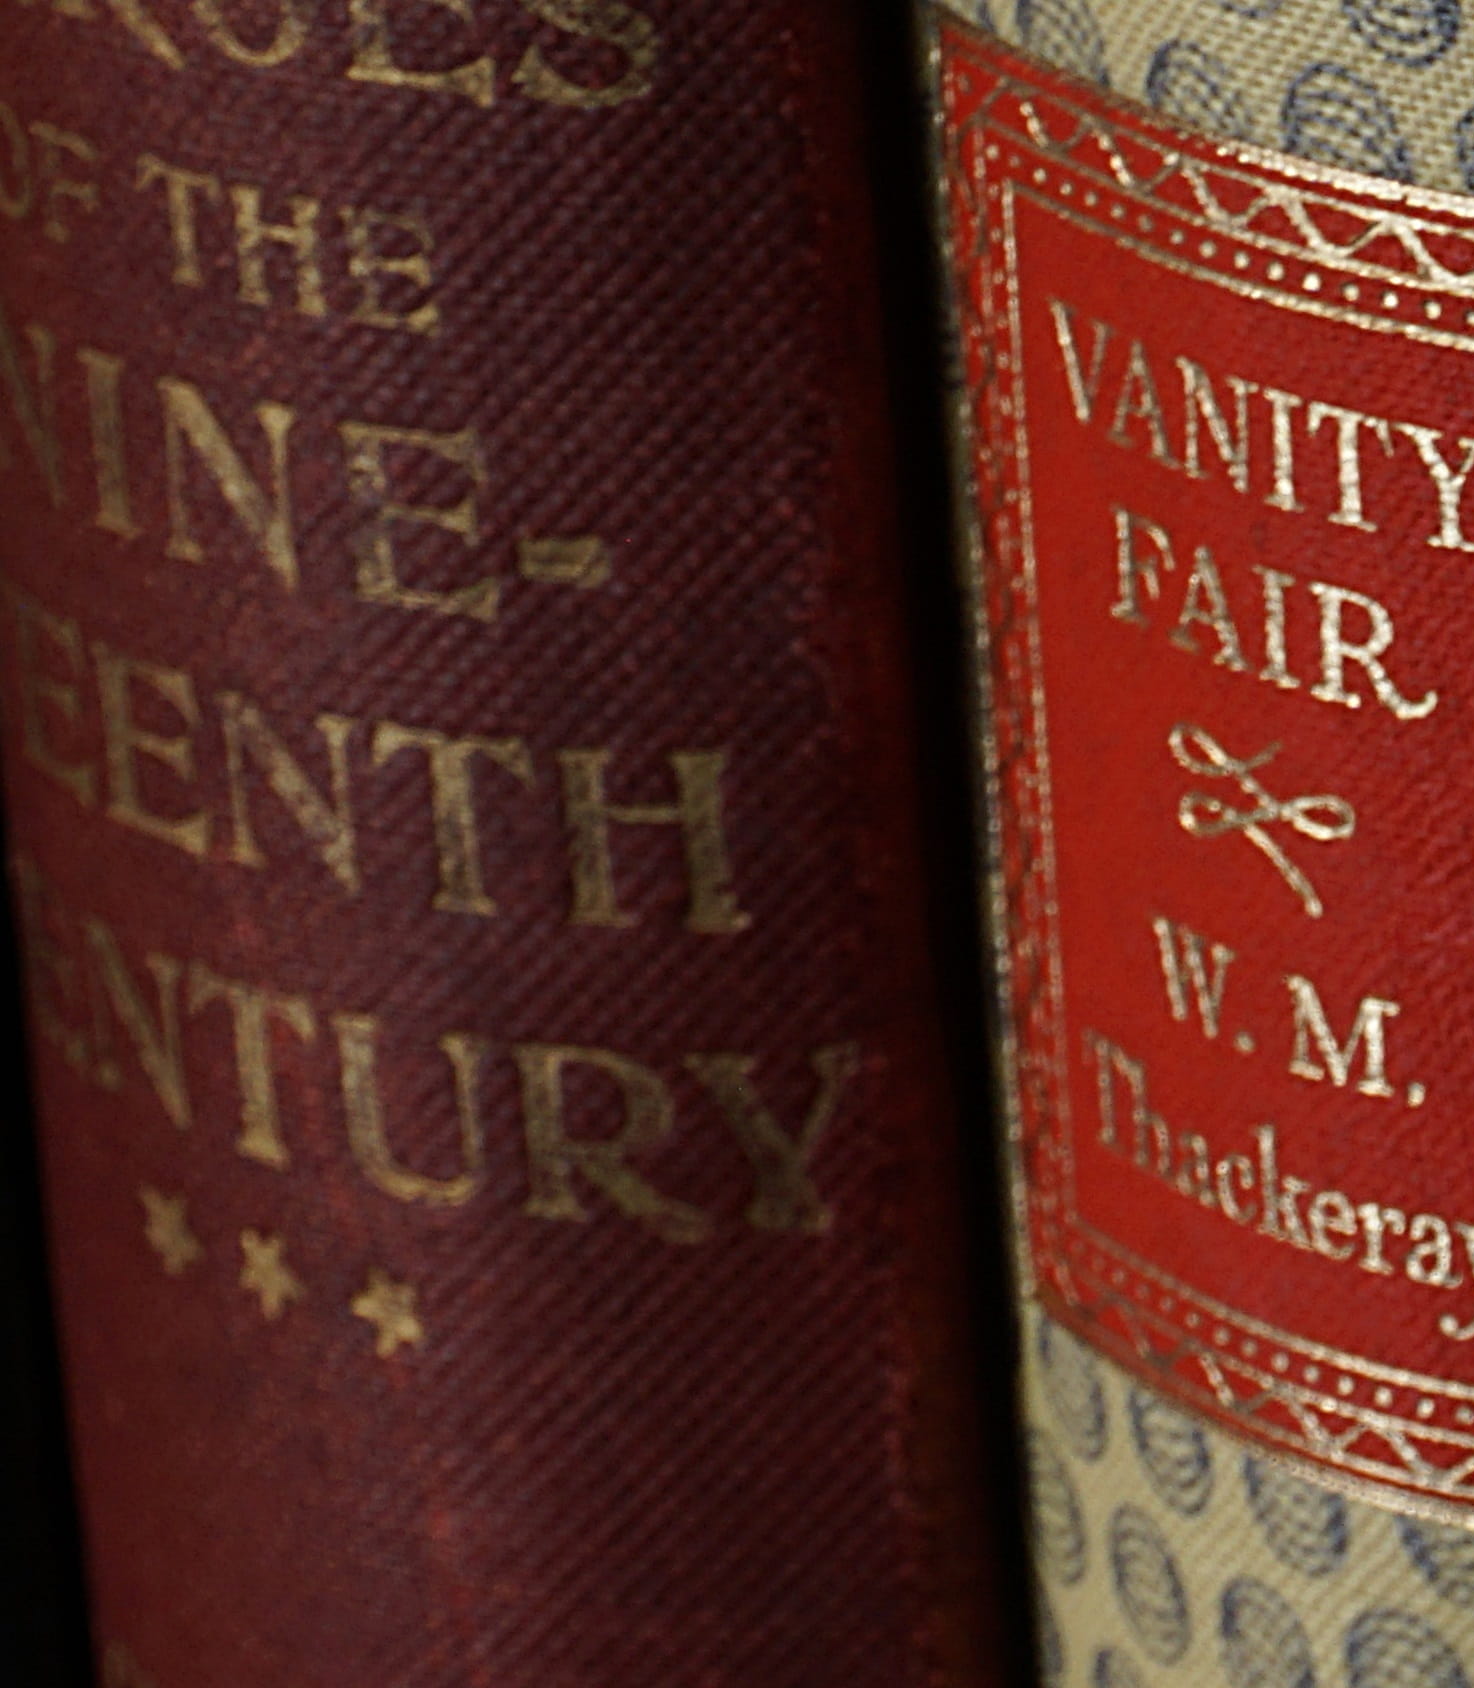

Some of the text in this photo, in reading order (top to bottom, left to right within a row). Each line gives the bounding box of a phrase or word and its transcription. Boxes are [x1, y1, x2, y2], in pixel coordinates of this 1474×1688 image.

[136, 153, 440, 337] THE
[1109, 504, 1438, 721] FAIR
[3, 580, 753, 936] EENTH
[1149, 915, 1427, 1108] W. M.
